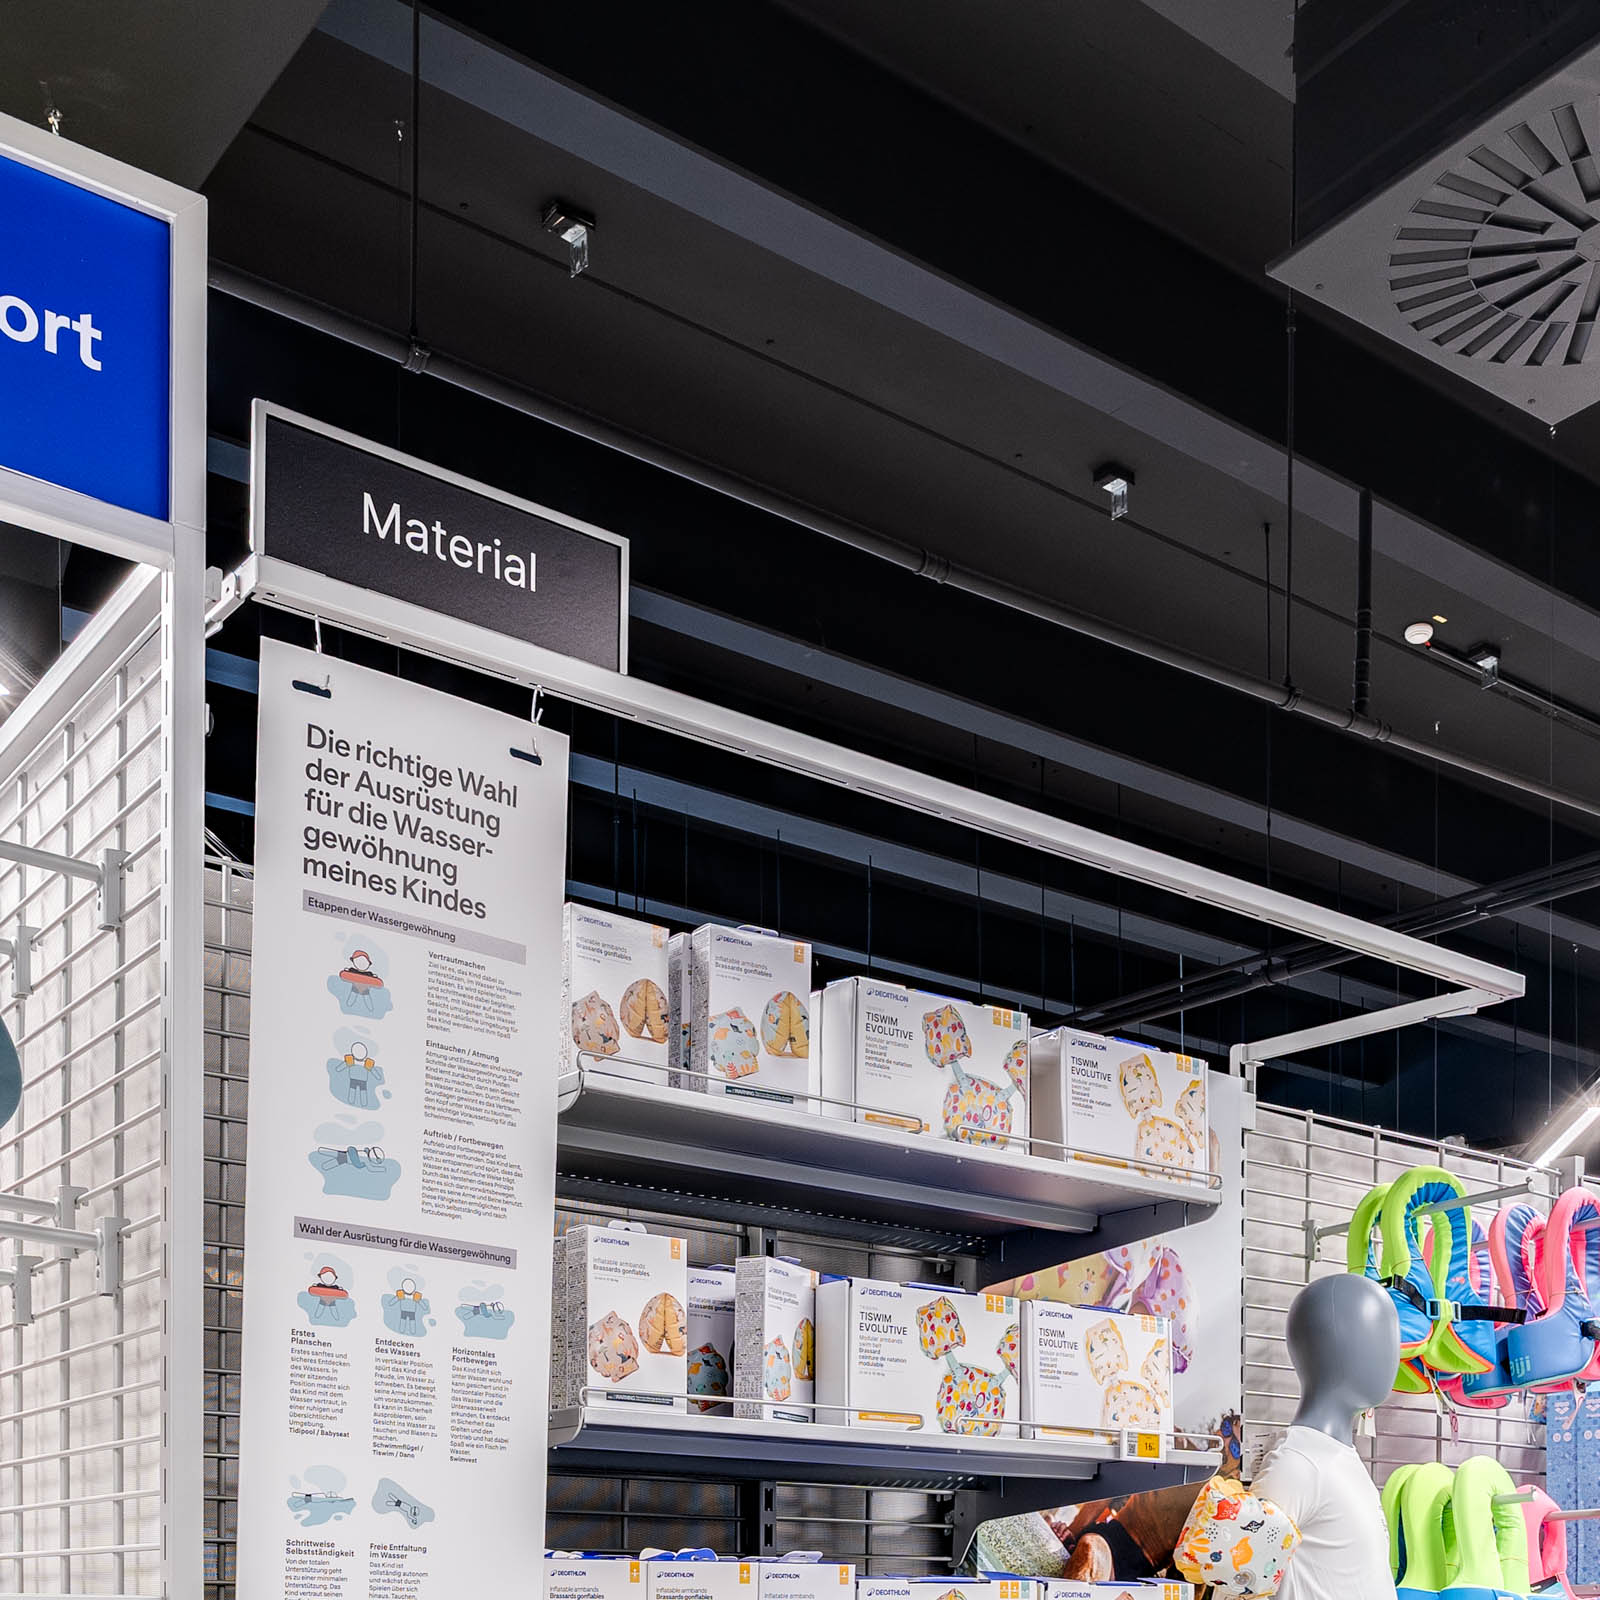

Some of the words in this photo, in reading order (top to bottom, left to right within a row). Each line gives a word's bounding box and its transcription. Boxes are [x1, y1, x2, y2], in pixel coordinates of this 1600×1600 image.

[361, 490, 540, 596] Material
[307, 723, 350, 757] Die
[355, 740, 453, 787] richtige
[458, 767, 518, 807] Wahl
[305, 758, 350, 788] der
[355, 770, 500, 837] Ausrüstung
[305, 788, 343, 818] für
[349, 801, 387, 830] die
[393, 810, 493, 858] Wasser-
[303, 825, 458, 885] gewöhnung
[303, 856, 397, 895] meines
[402, 875, 487, 919] Kindes
[308, 897, 349, 916] Etappen
[351, 908, 366, 920] der
[368, 910, 456, 942] Wassergewöhnung
[428, 951, 486, 971] Vertrautmachen
[874, 989, 909, 1003] DECATHLON
[867, 1012, 898, 1026] TISWIM
[865, 1023, 913, 1041] EVOLUTIVE
[426, 1040, 466, 1055] Eintauchen
[472, 1051, 499, 1063] Atmung
[1071, 1056, 1099, 1069] TISWIM
[1071, 1066, 1112, 1082] EVOLUTIVE
[424, 1129, 452, 1140] Auftrieb
[459, 1136, 503, 1150] Fortbewegen
[300, 1223, 324, 1235] Wahl
[326, 1227, 341, 1239] der
[343, 1230, 398, 1247] Ausrüstung
[399, 1239, 414, 1248] für
[414, 1240, 427, 1250] die
[429, 1242, 511, 1264] Wassergewöhnung
[868, 1288, 902, 1298] DECATHLON
[859, 1311, 892, 1322] TISWIM
[291, 1329, 315, 1338] Erstes
[859, 1323, 907, 1335] EVOLUTIVE
[1039, 1328, 1065, 1338] TISWIM
[291, 1337, 332, 1348] Planschen
[375, 1338, 414, 1348] Entdecken
[1039, 1338, 1078, 1350] EVOLUTIVE
[390, 1348, 421, 1357] Wassers
[452, 1347, 496, 1358] Horizontales
[452, 1355, 497, 1366] Fortbewegen
[320, 1430, 349, 1438] Babyseat
[286, 1539, 335, 1548] Schrittweise
[389, 1543, 427, 1554] Entfaltung
[286, 1548, 354, 1558] Selbstständigkeit
